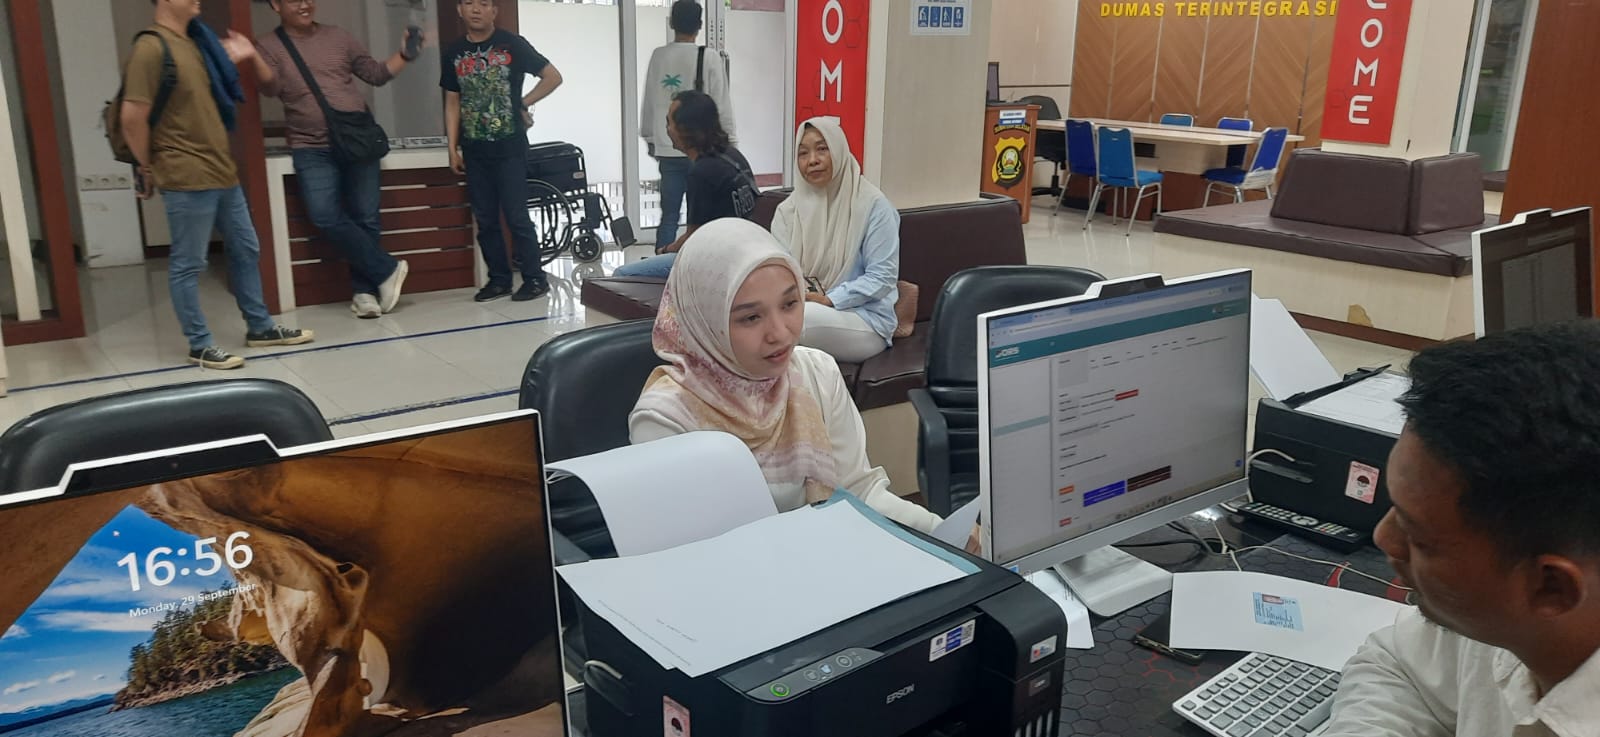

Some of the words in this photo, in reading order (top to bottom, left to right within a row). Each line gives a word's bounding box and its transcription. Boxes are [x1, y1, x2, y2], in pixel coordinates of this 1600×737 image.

[1100, 3, 1165, 17] DUMAS
[1175, 0, 1338, 17] TERINTEGRASI
[117, 531, 254, 592] 16:56
[129, 601, 179, 618] Monday,
[182, 595, 195, 607] 29
[198, 583, 256, 602] September
[886, 683, 915, 704] EPSON
